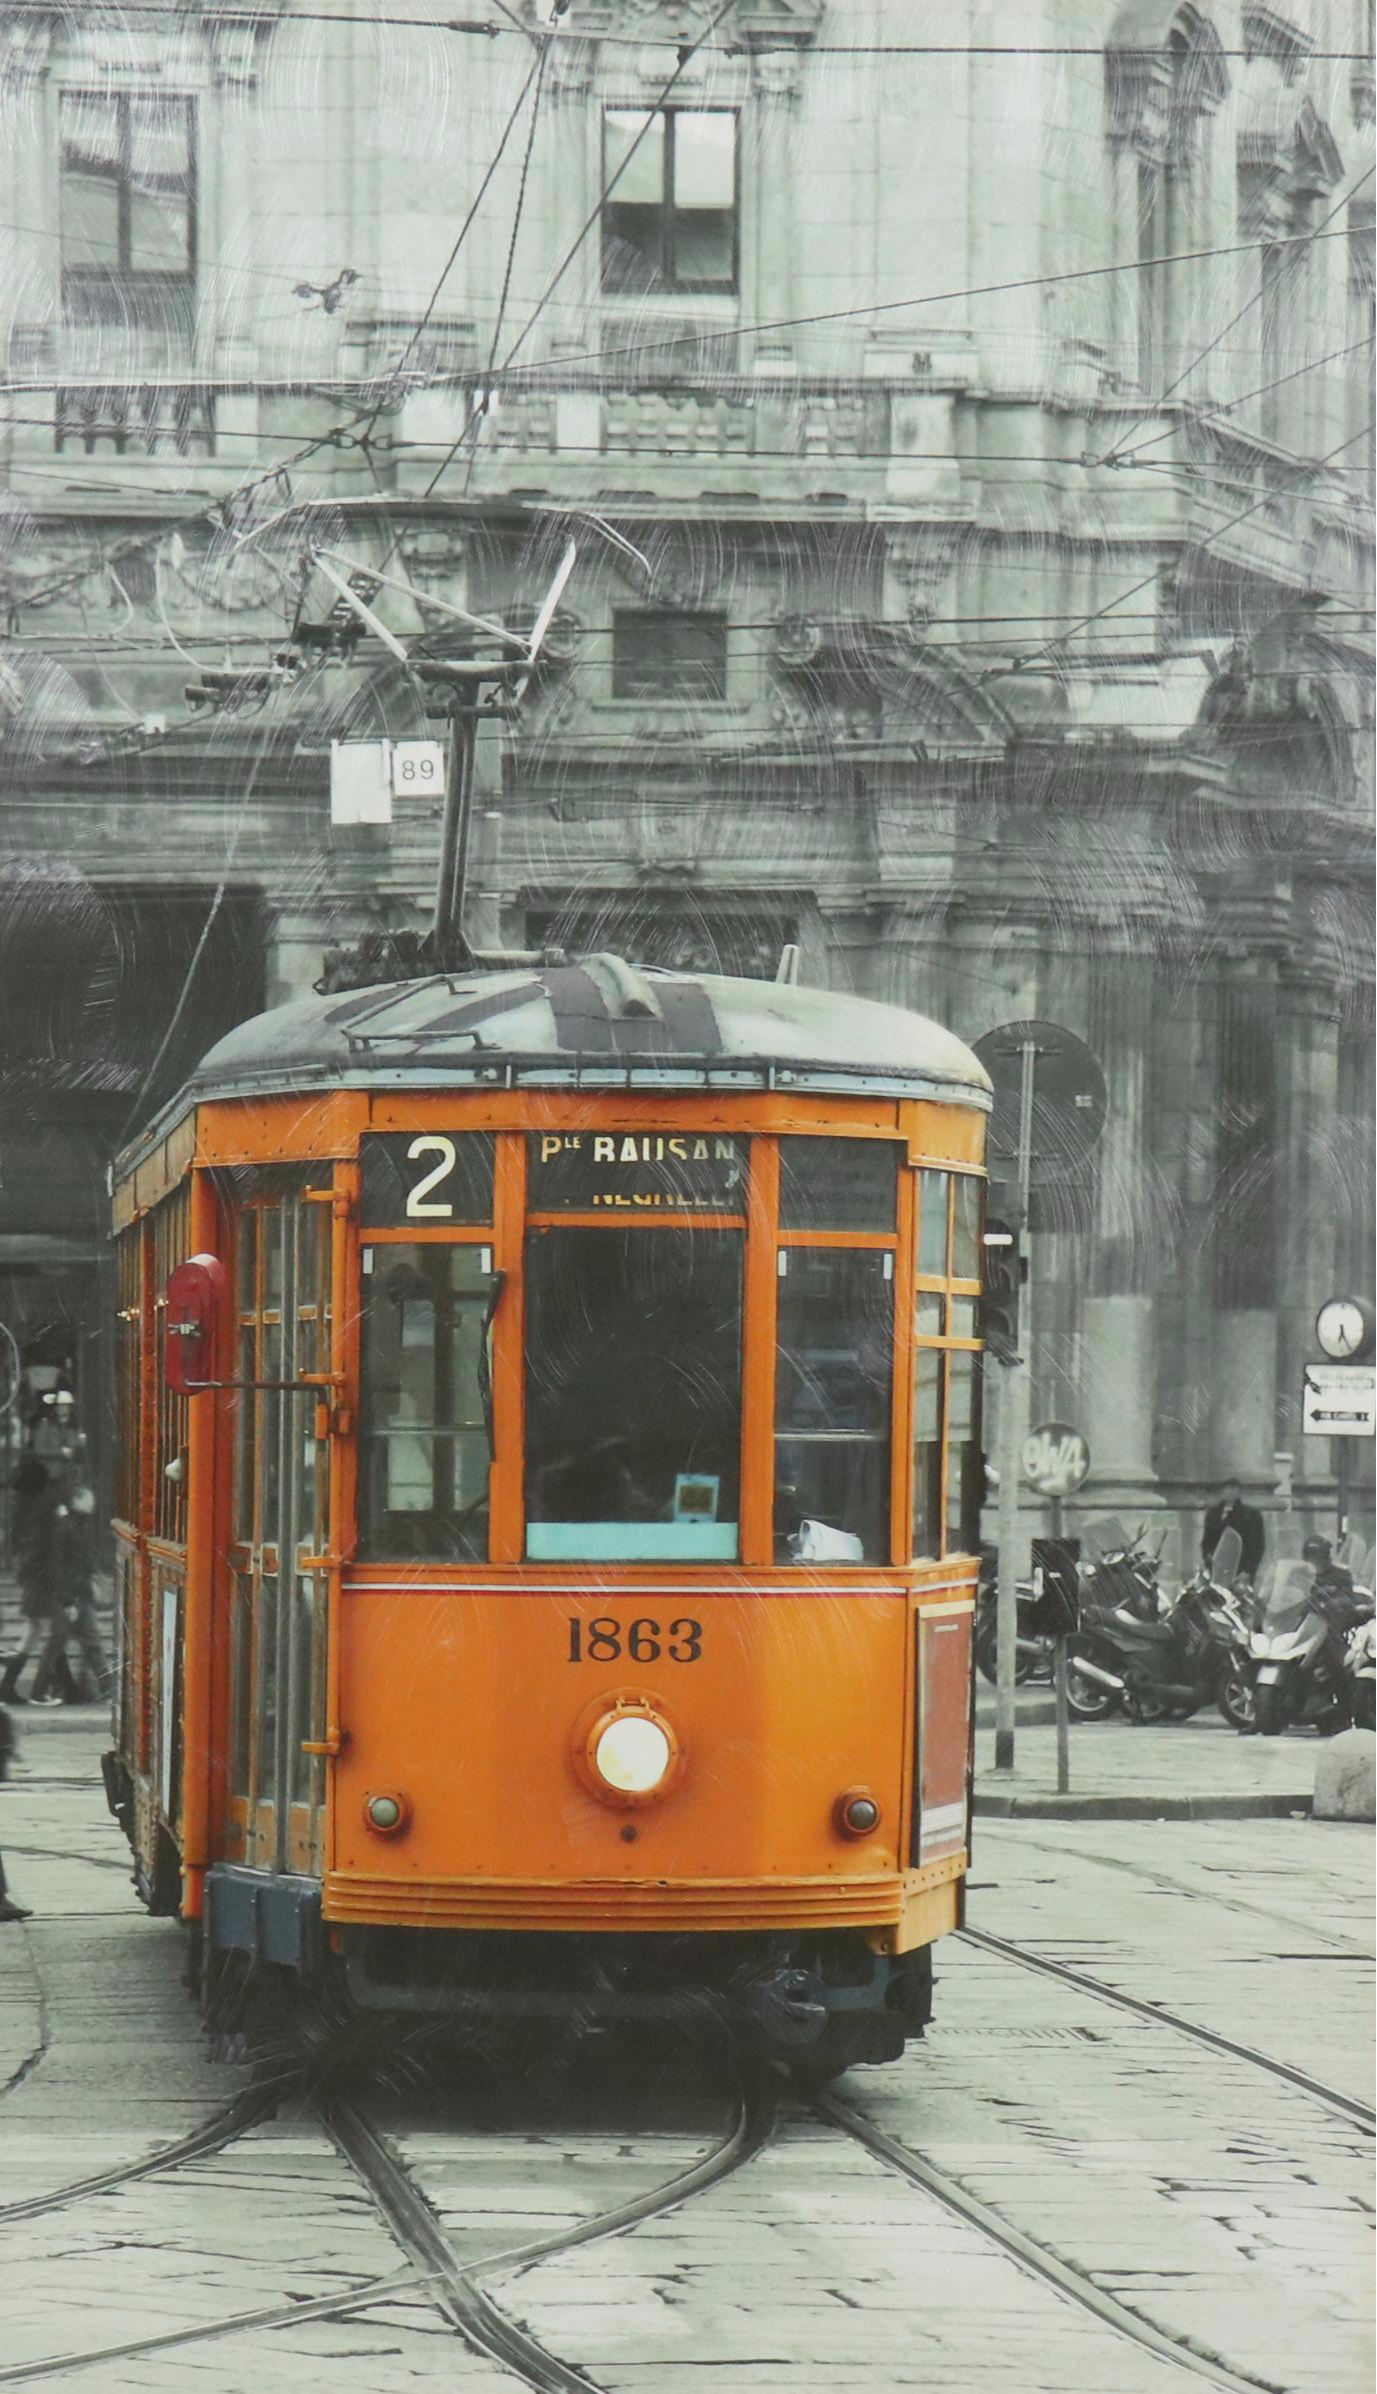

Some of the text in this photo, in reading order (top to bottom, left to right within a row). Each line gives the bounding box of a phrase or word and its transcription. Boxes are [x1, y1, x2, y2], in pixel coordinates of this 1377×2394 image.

[401, 759, 435, 781] 89
[406, 1135, 457, 1217] 2
[567, 1616, 703, 1663] 1863
